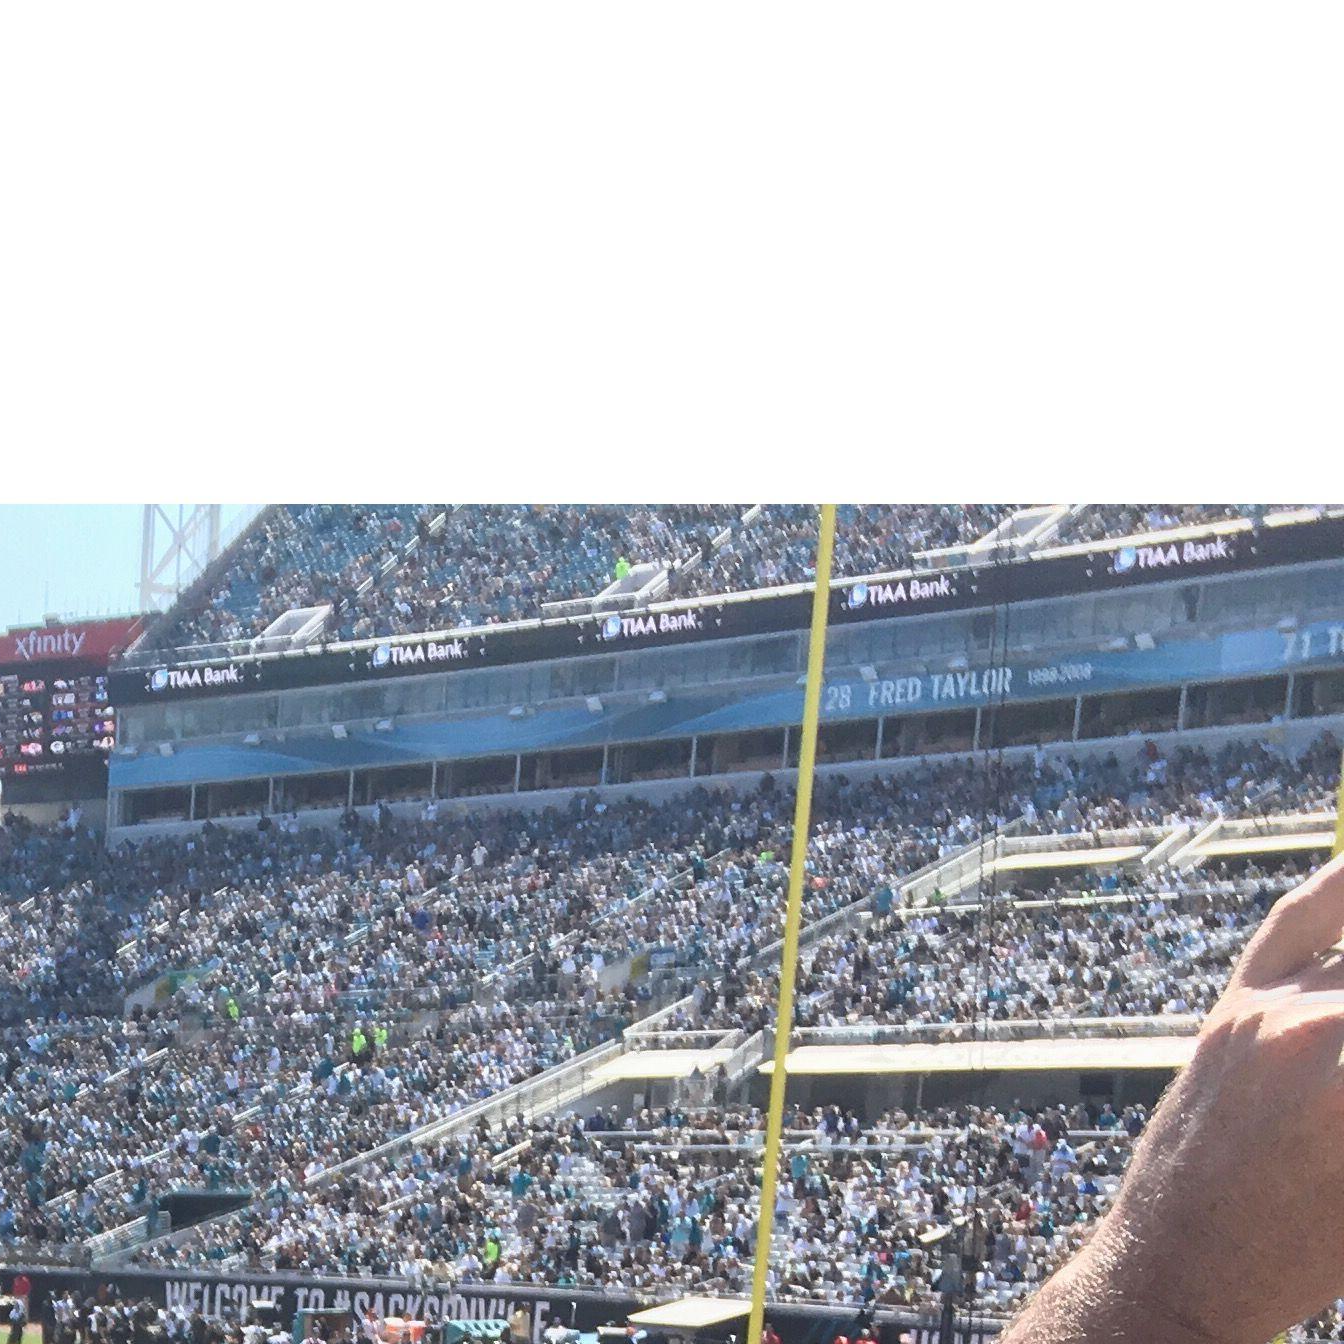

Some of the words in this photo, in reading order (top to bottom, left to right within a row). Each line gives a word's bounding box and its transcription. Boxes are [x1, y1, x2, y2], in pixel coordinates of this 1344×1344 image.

[1136, 545, 1181, 569] TIAA
[1182, 537, 1229, 562] Bank
[867, 581, 907, 605] TIAA
[909, 575, 951, 600] Bank
[620, 615, 657, 637] TIAA
[659, 609, 698, 632] Bank
[15, 629, 86, 661] xfinity
[390, 644, 425, 665] TIAA
[427, 639, 463, 661] Bank
[168, 669, 202, 688] TIAA
[204, 663, 239, 685] Bank
[868, 677, 922, 706] FRED
[930, 667, 1013, 700] TAYLOR
